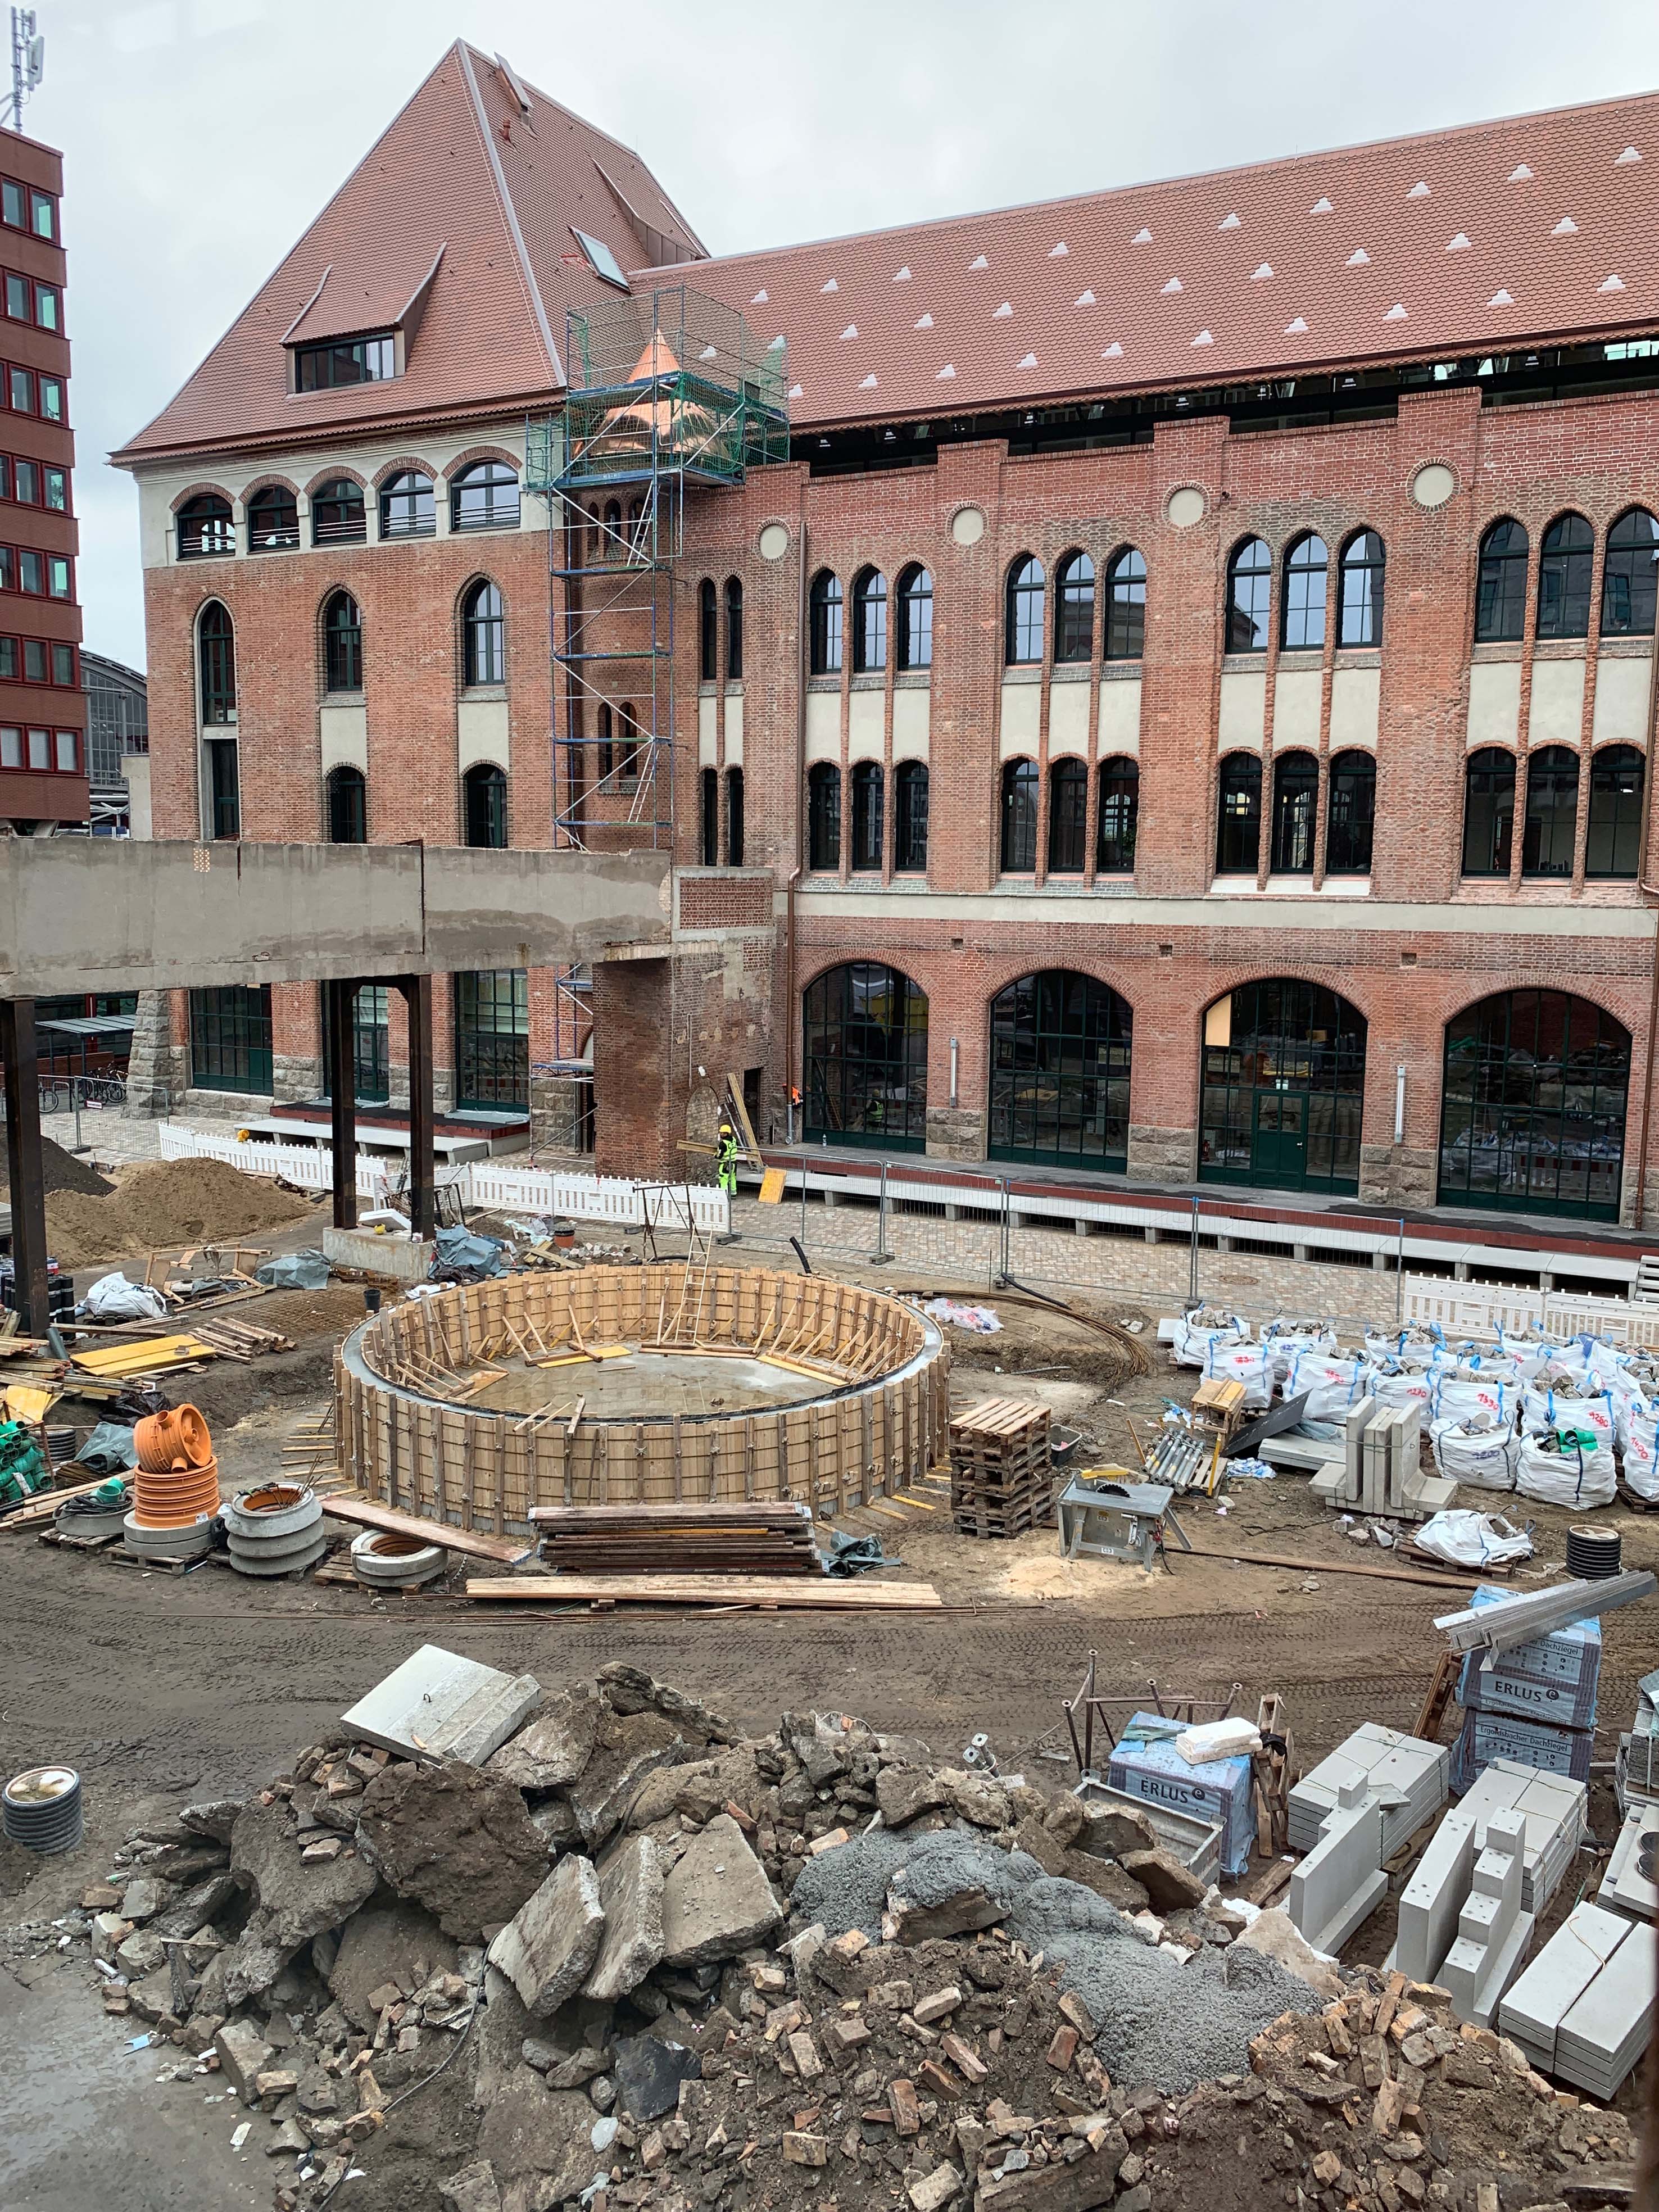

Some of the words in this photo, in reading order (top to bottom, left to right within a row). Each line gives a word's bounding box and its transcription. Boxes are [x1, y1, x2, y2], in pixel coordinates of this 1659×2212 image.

[1477, 1394, 1499, 1411] 1330
[1631, 1437, 1649, 1459] 1400
[1540, 1640, 1579, 1655] Dachziegel
[1495, 1680, 1542, 1702] ERLUS
[1480, 1726, 1527, 1742] Ergoldsbacher
[1530, 1737, 1567, 1752] Dachziegel
[1140, 1779, 1188, 1803] ERLUS
